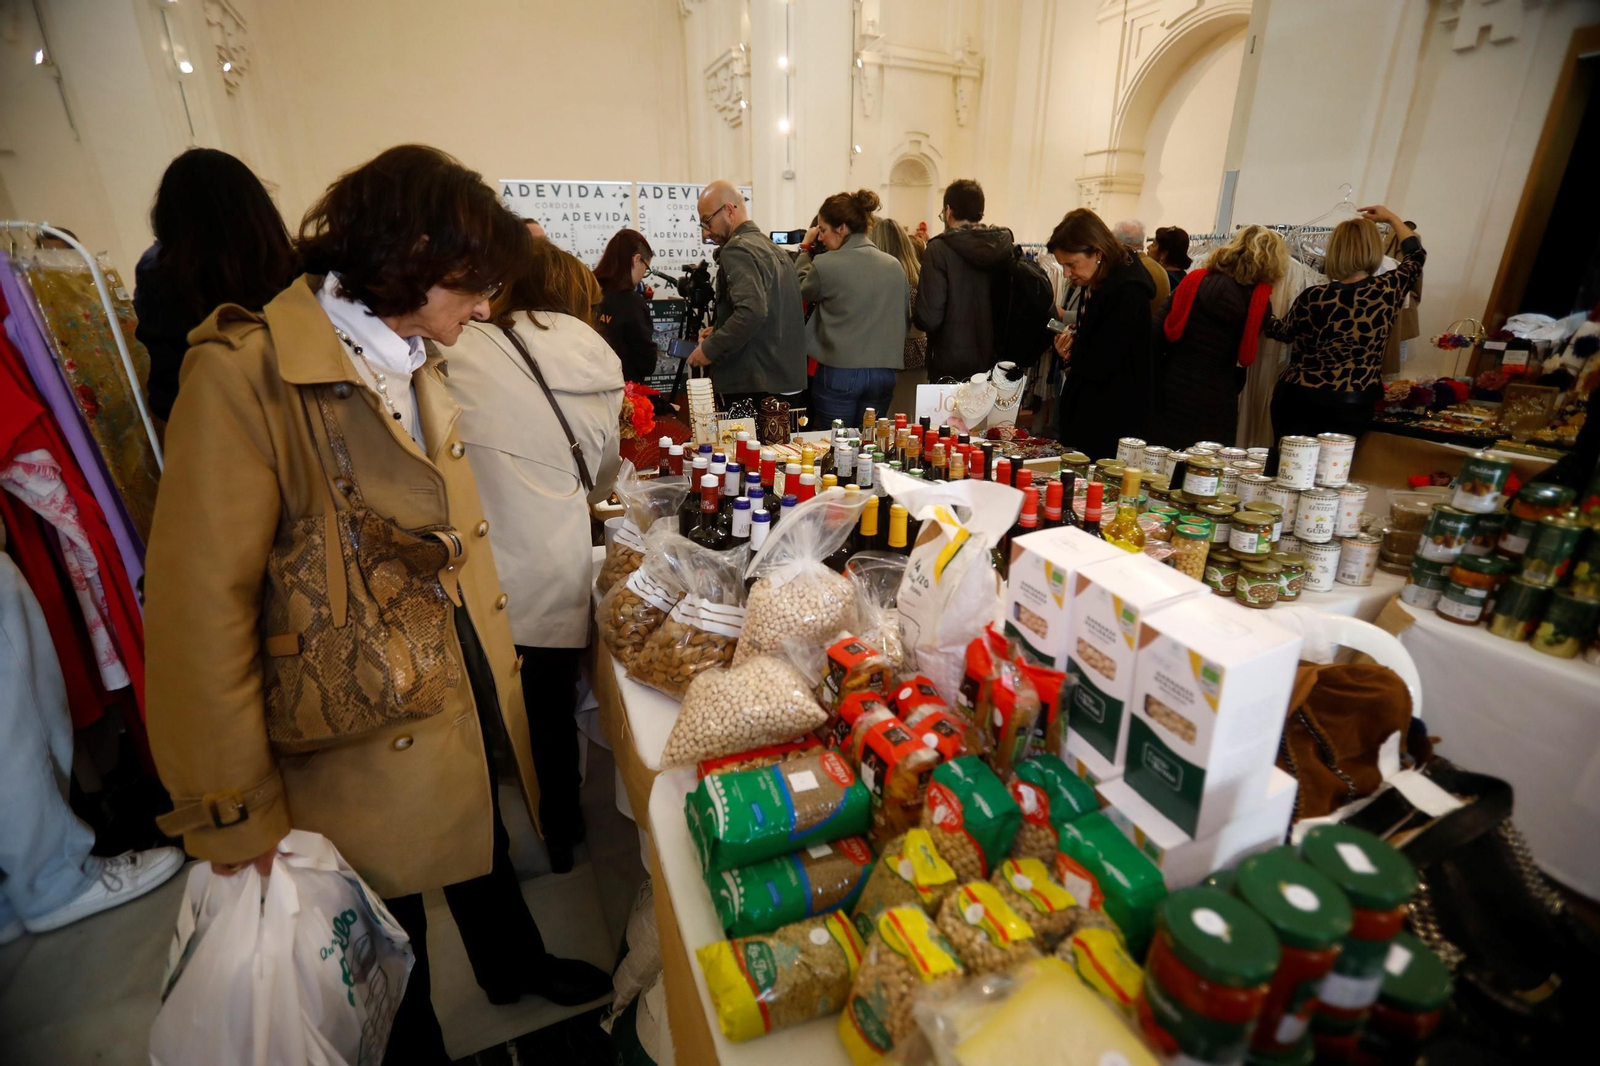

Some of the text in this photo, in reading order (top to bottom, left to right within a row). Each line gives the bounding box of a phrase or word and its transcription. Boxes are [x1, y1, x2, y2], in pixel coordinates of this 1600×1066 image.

[502, 184, 605, 198] ADEVIDA
[638, 186, 700, 200] ADEVI
[561, 212, 631, 222] ADEVIDA
[653, 231, 695, 239] ADEVIDA
[1279, 473, 1294, 481] ISO
[1306, 527, 1331, 535] GUISO
[825, 752, 850, 783] PEDRO
[930, 787, 958, 827] PERO
